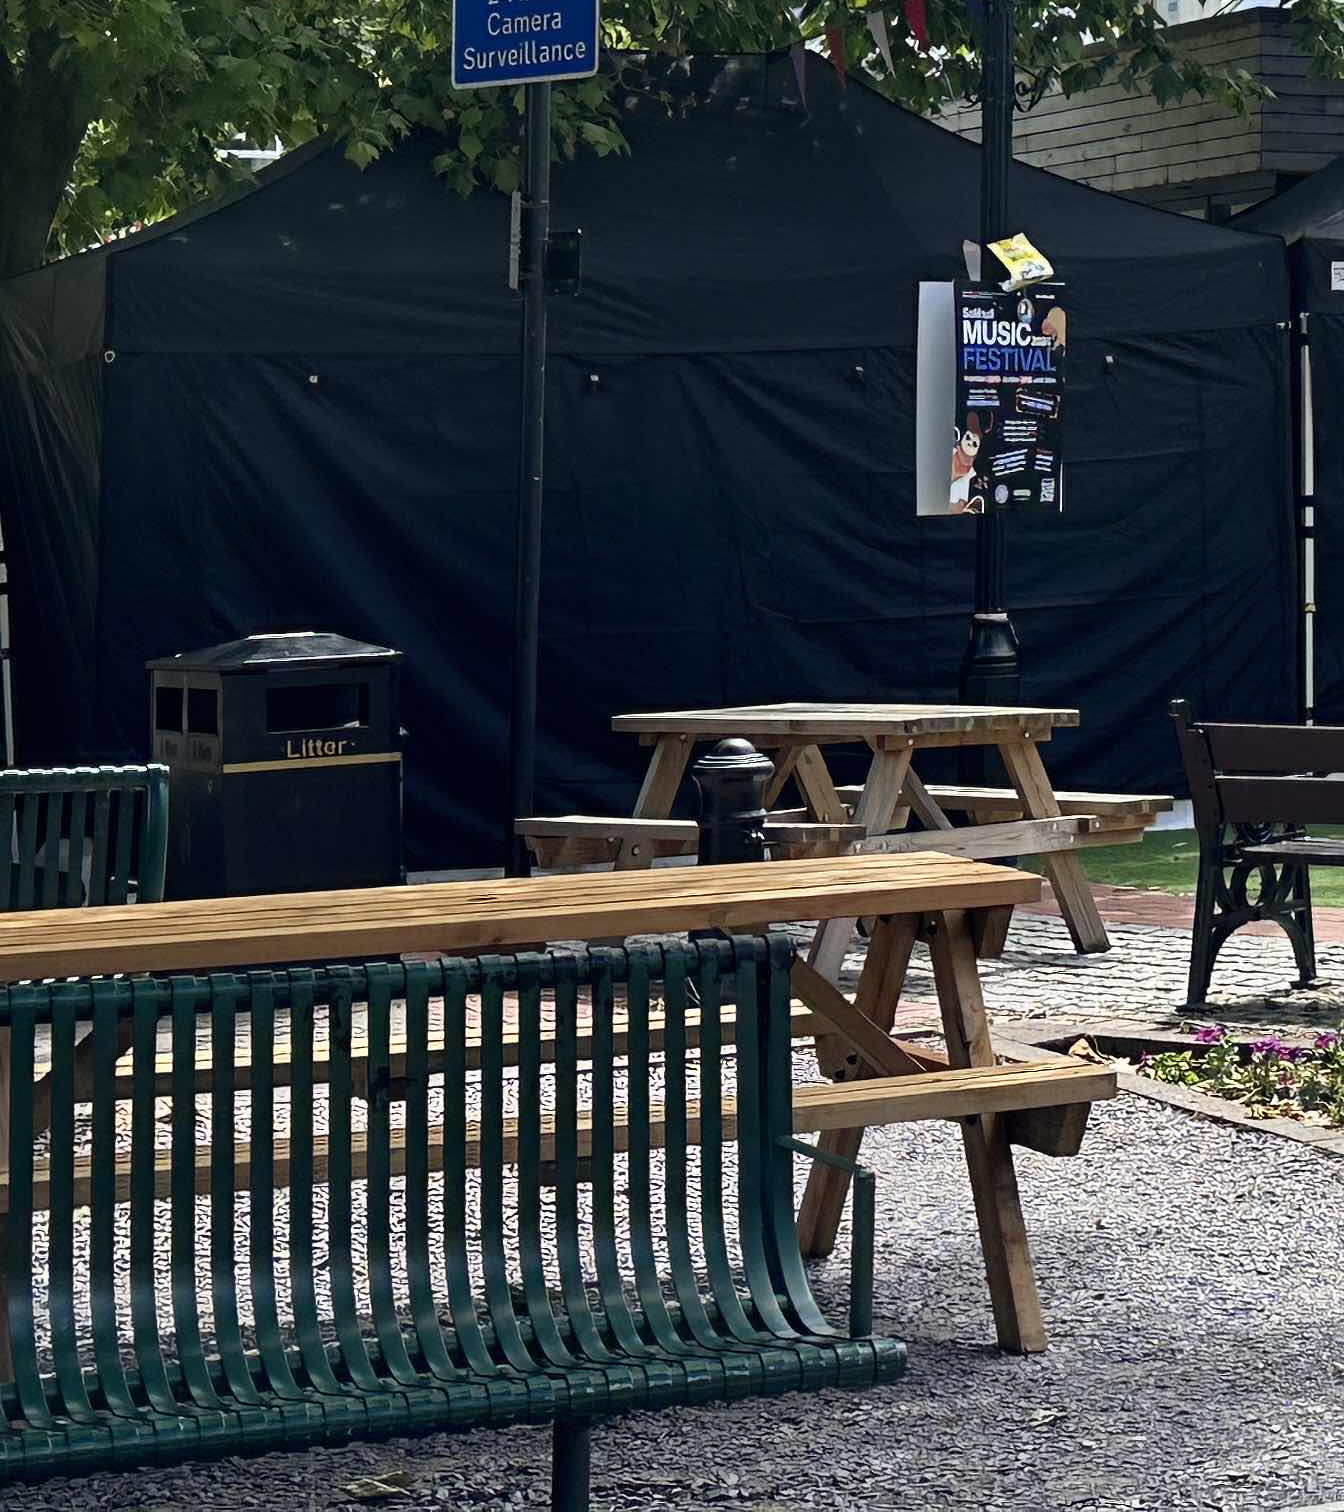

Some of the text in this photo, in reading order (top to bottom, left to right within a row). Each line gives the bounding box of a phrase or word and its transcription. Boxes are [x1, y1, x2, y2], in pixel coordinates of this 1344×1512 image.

[487, 11, 561, 36] Camera
[463, 40, 586, 70] Surveillance
[962, 320, 1032, 346] MUSIC
[963, 347, 1057, 372] FESTIVAL
